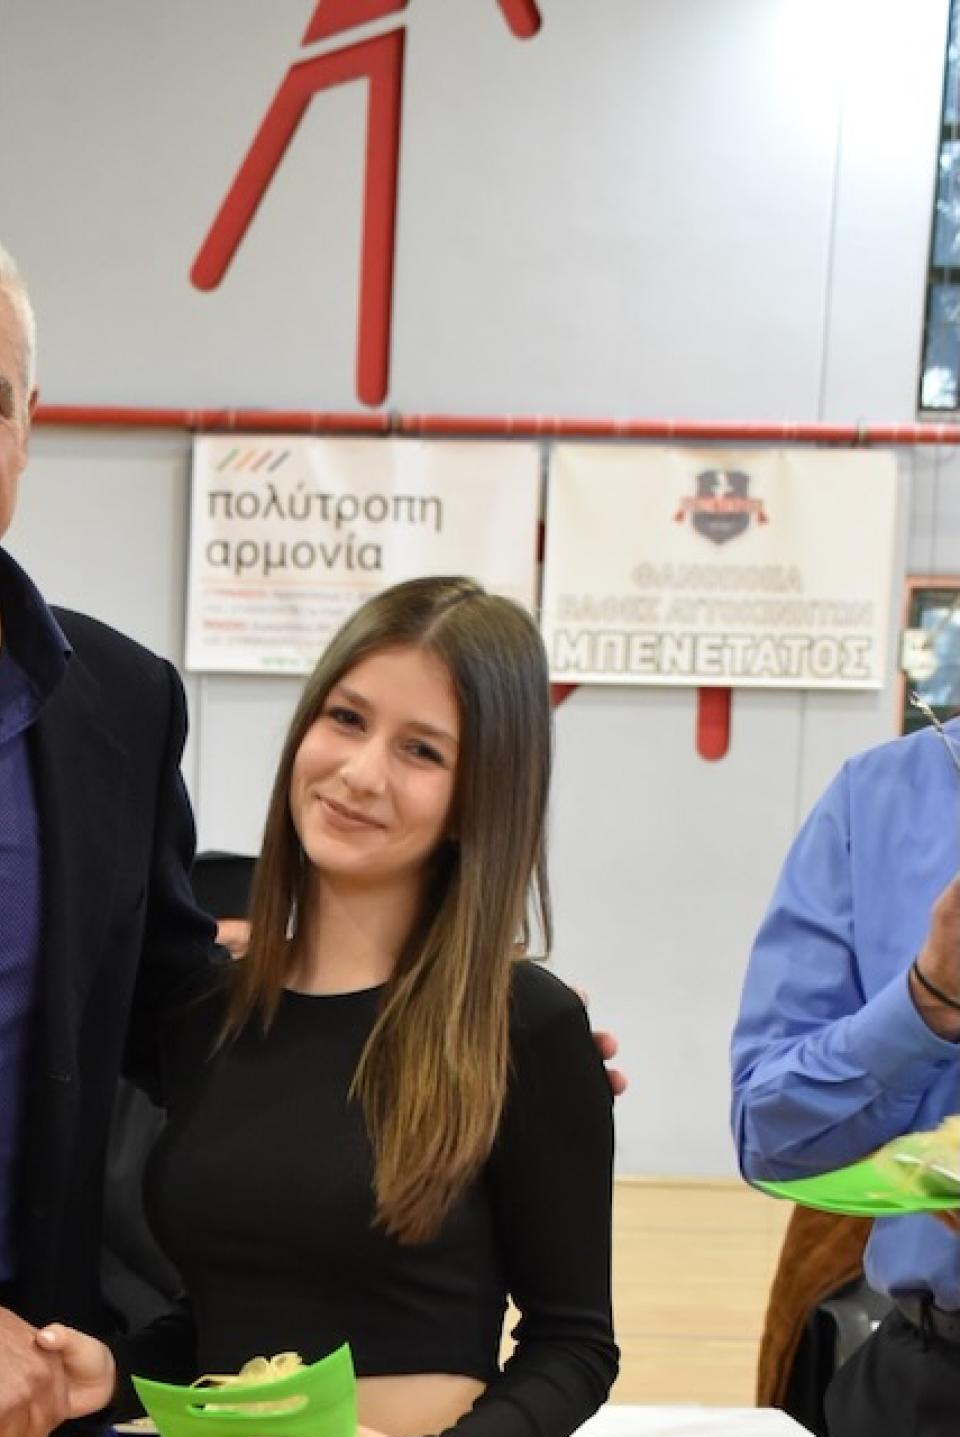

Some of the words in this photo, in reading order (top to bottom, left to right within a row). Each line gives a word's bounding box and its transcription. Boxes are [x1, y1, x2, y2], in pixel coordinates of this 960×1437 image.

[207, 482, 442, 532] πολύτροπη
[206, 533, 383, 576] αρμονία
[553, 628, 873, 678] ΜΠΕΝΕΤΑΤΟΣ
